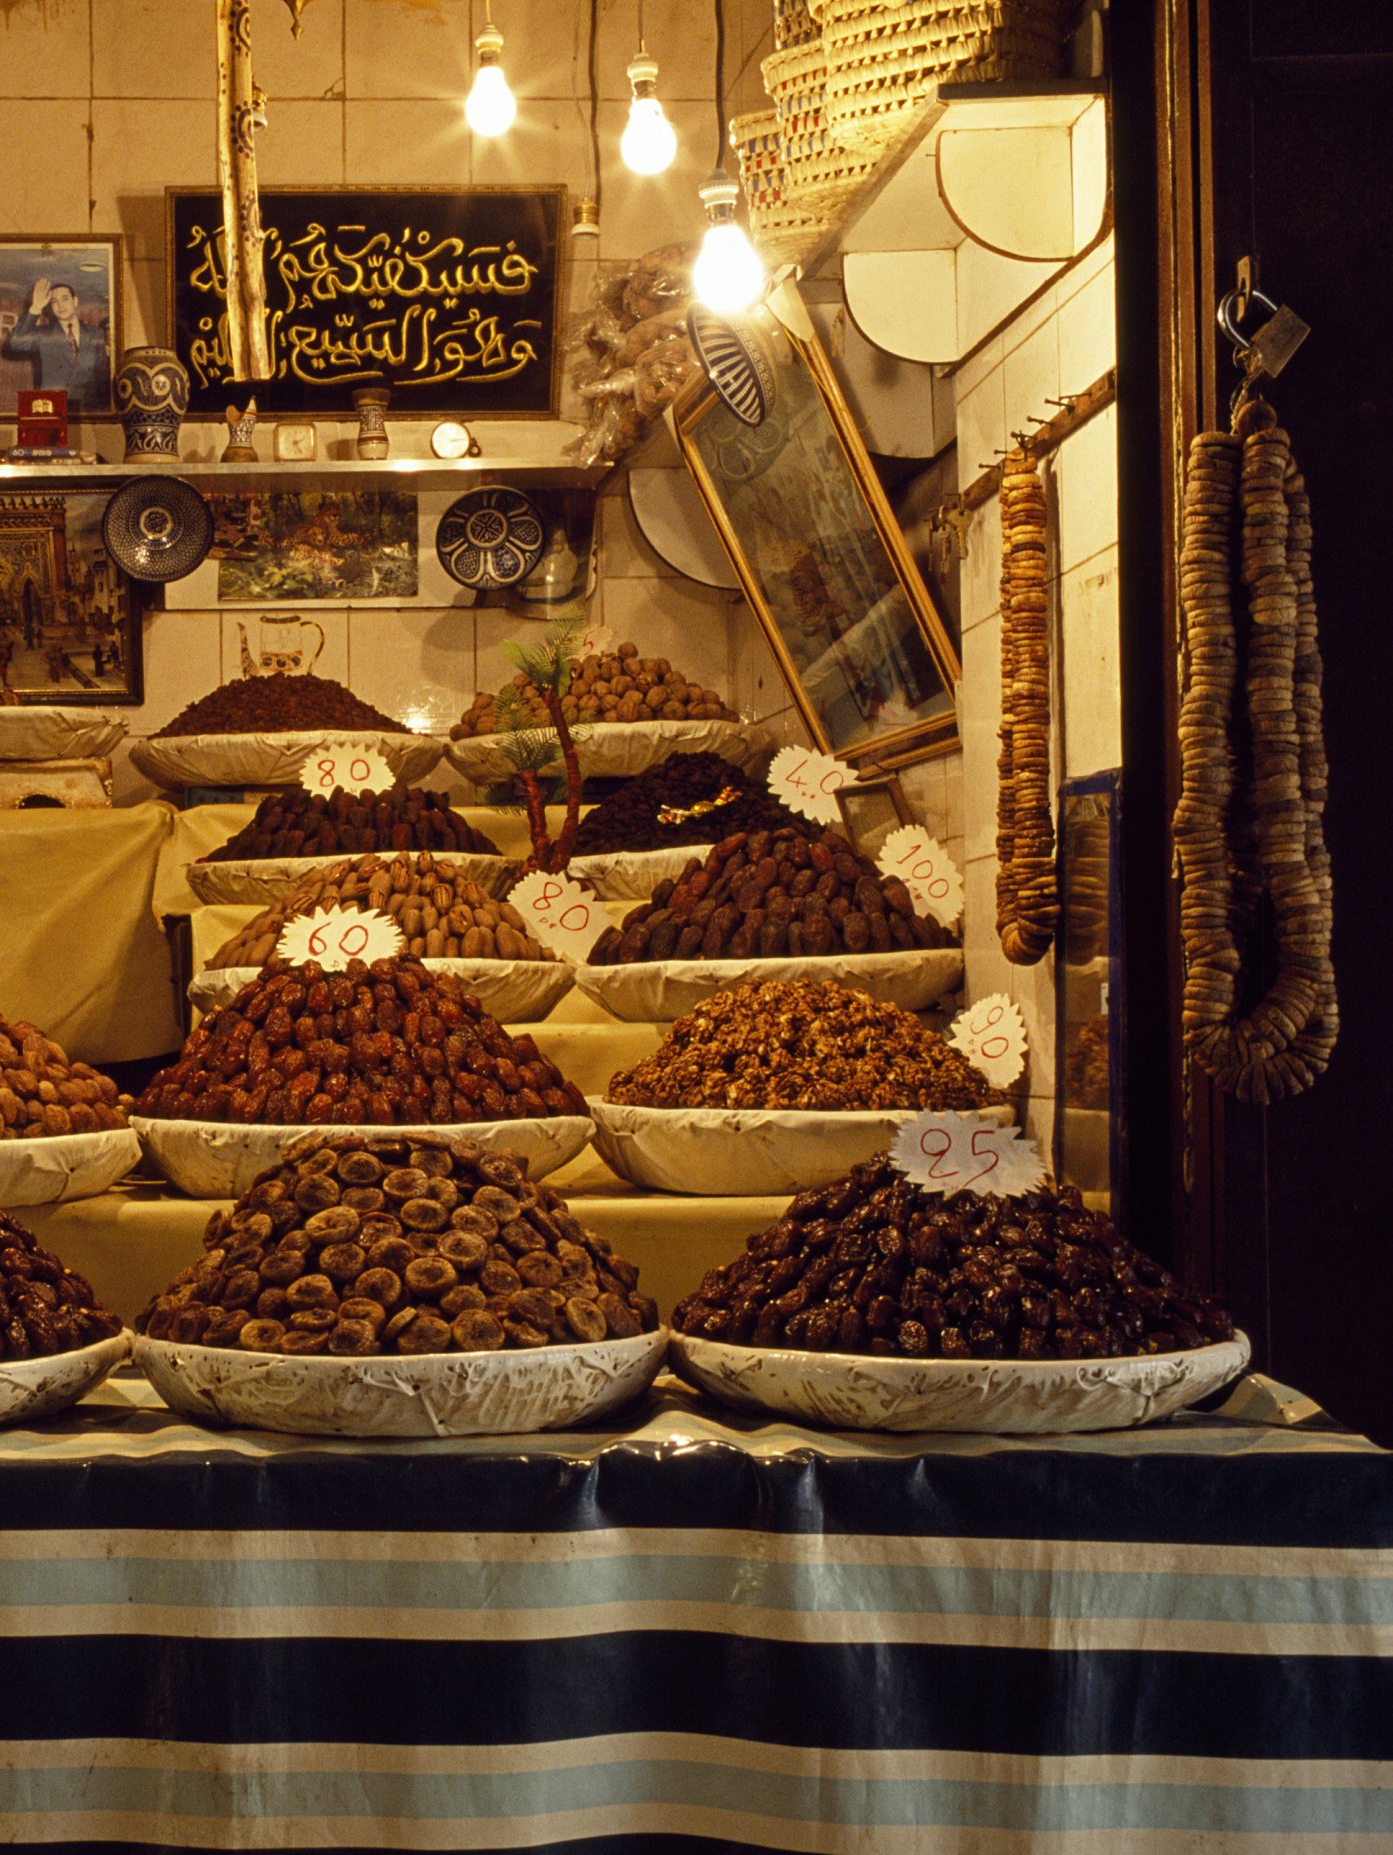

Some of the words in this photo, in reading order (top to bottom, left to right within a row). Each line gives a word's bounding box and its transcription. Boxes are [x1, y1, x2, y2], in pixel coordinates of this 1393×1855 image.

[317, 759, 371, 787] 80
[785, 759, 844, 795] 40
[895, 844, 950, 899] 100
[533, 881, 590, 932] 80
[308, 921, 369, 956] 60
[969, 1005, 1009, 1059] 90
